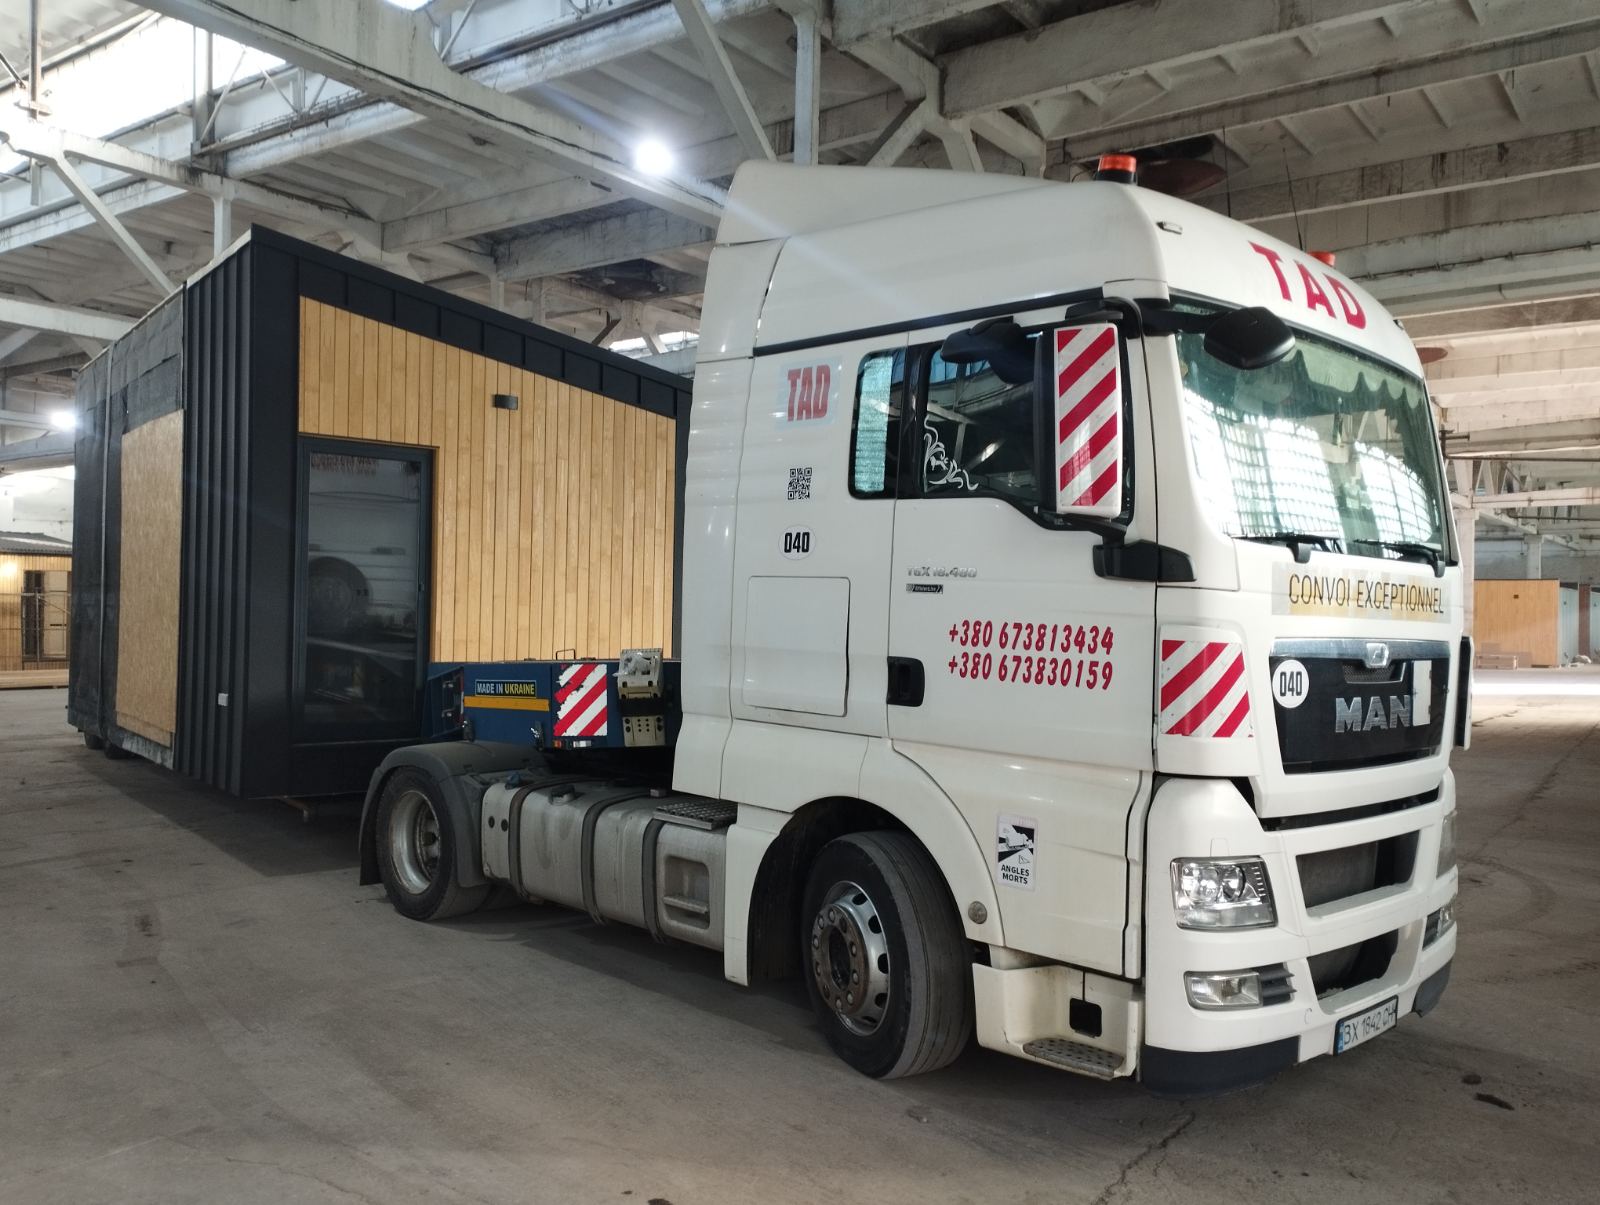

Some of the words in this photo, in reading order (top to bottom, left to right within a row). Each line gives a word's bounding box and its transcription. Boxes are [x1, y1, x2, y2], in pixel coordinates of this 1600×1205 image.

[1248, 240, 1366, 330] TAD
[788, 364, 831, 421] TAD
[784, 532, 810, 553] 040
[1289, 573, 1351, 606] CONVOI
[1356, 579, 1444, 614] EXCEPTIONNEL
[949, 619, 993, 648] +380
[999, 621, 1114, 655] 673813434
[949, 651, 993, 680] +380
[998, 654, 1113, 690] 673830159
[1280, 671, 1303, 697] 040
[477, 683, 495, 694] MADE
[496, 683, 504, 694] IN
[504, 683, 535, 695] UKRAINE
[1335, 694, 1411, 733] MAN
[1001, 864, 1030, 877] ANGLES
[1002, 872, 1028, 885] MORTS
